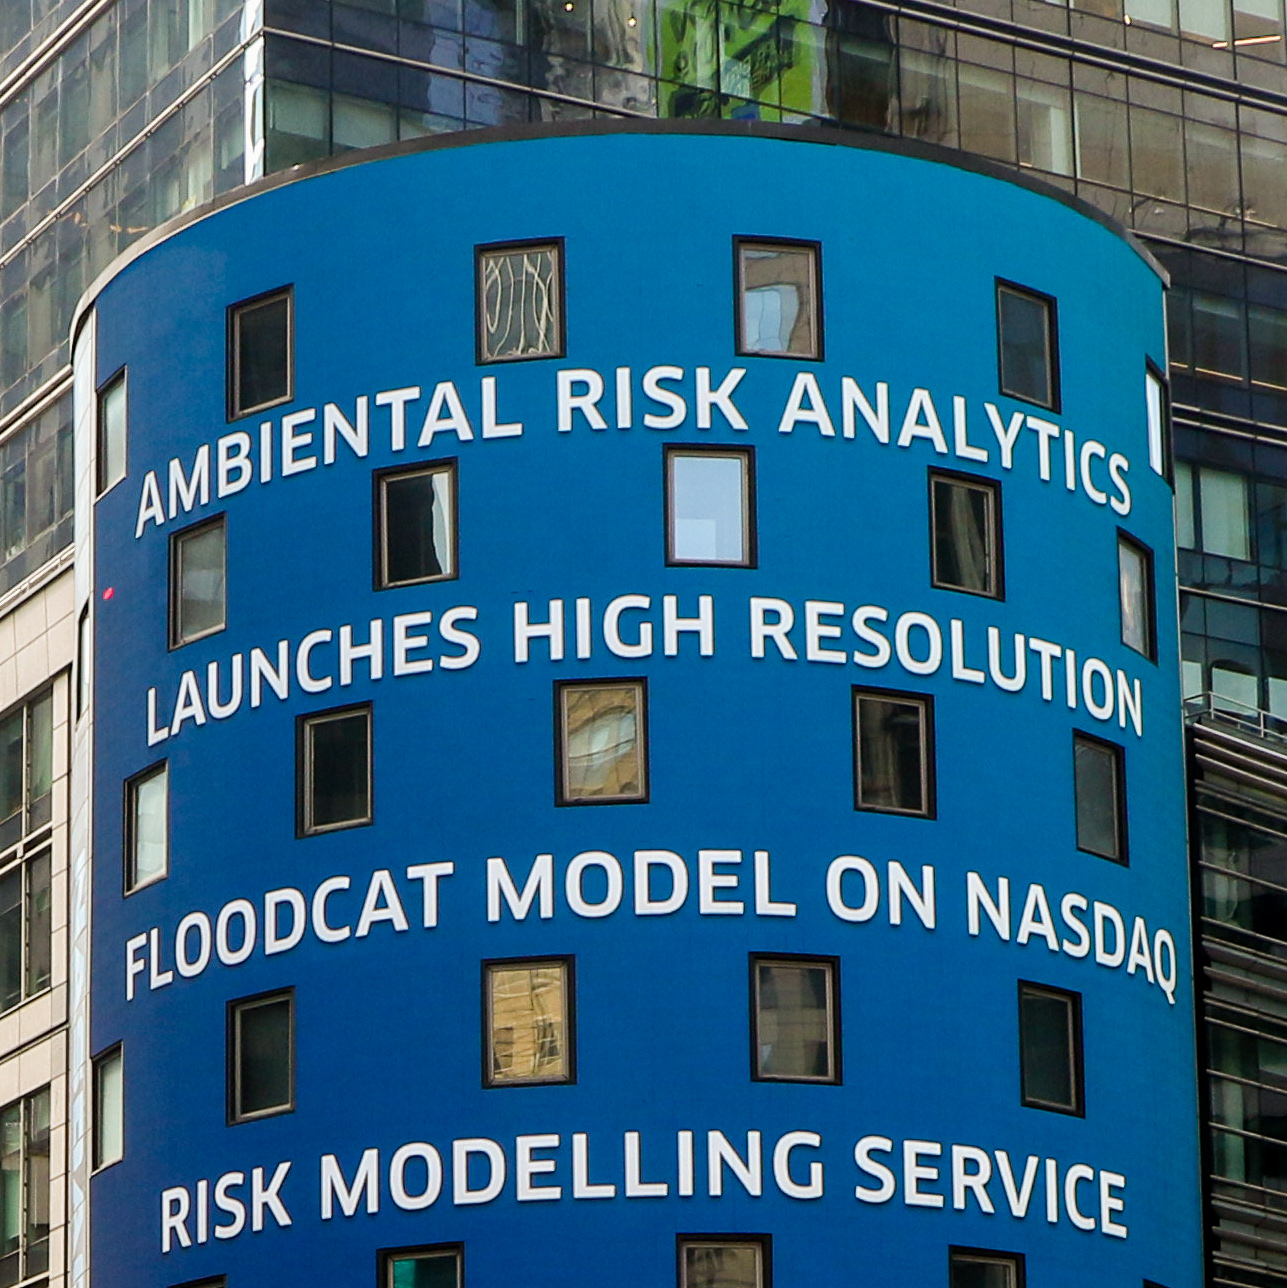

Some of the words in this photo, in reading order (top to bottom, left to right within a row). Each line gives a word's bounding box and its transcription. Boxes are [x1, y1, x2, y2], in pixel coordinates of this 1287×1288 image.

[135, 376, 524, 540] AMBIENTAL
[557, 365, 750, 433] RISK
[778, 372, 1132, 516] ANALYTICS
[147, 605, 481, 749] LAUNCHES
[514, 595, 715, 664] HIGH
[750, 597, 1143, 738] RESOLUTION
[125, 862, 455, 1002] FLOODCAT
[487, 850, 798, 923] MODEL
[826, 855, 936, 930] ON
[967, 871, 1177, 1005] NASDAQ
[162, 1161, 293, 1254] RISK
[321, 1130, 824, 1221] MODELLING
[854, 1136, 1128, 1239] SERVICE
